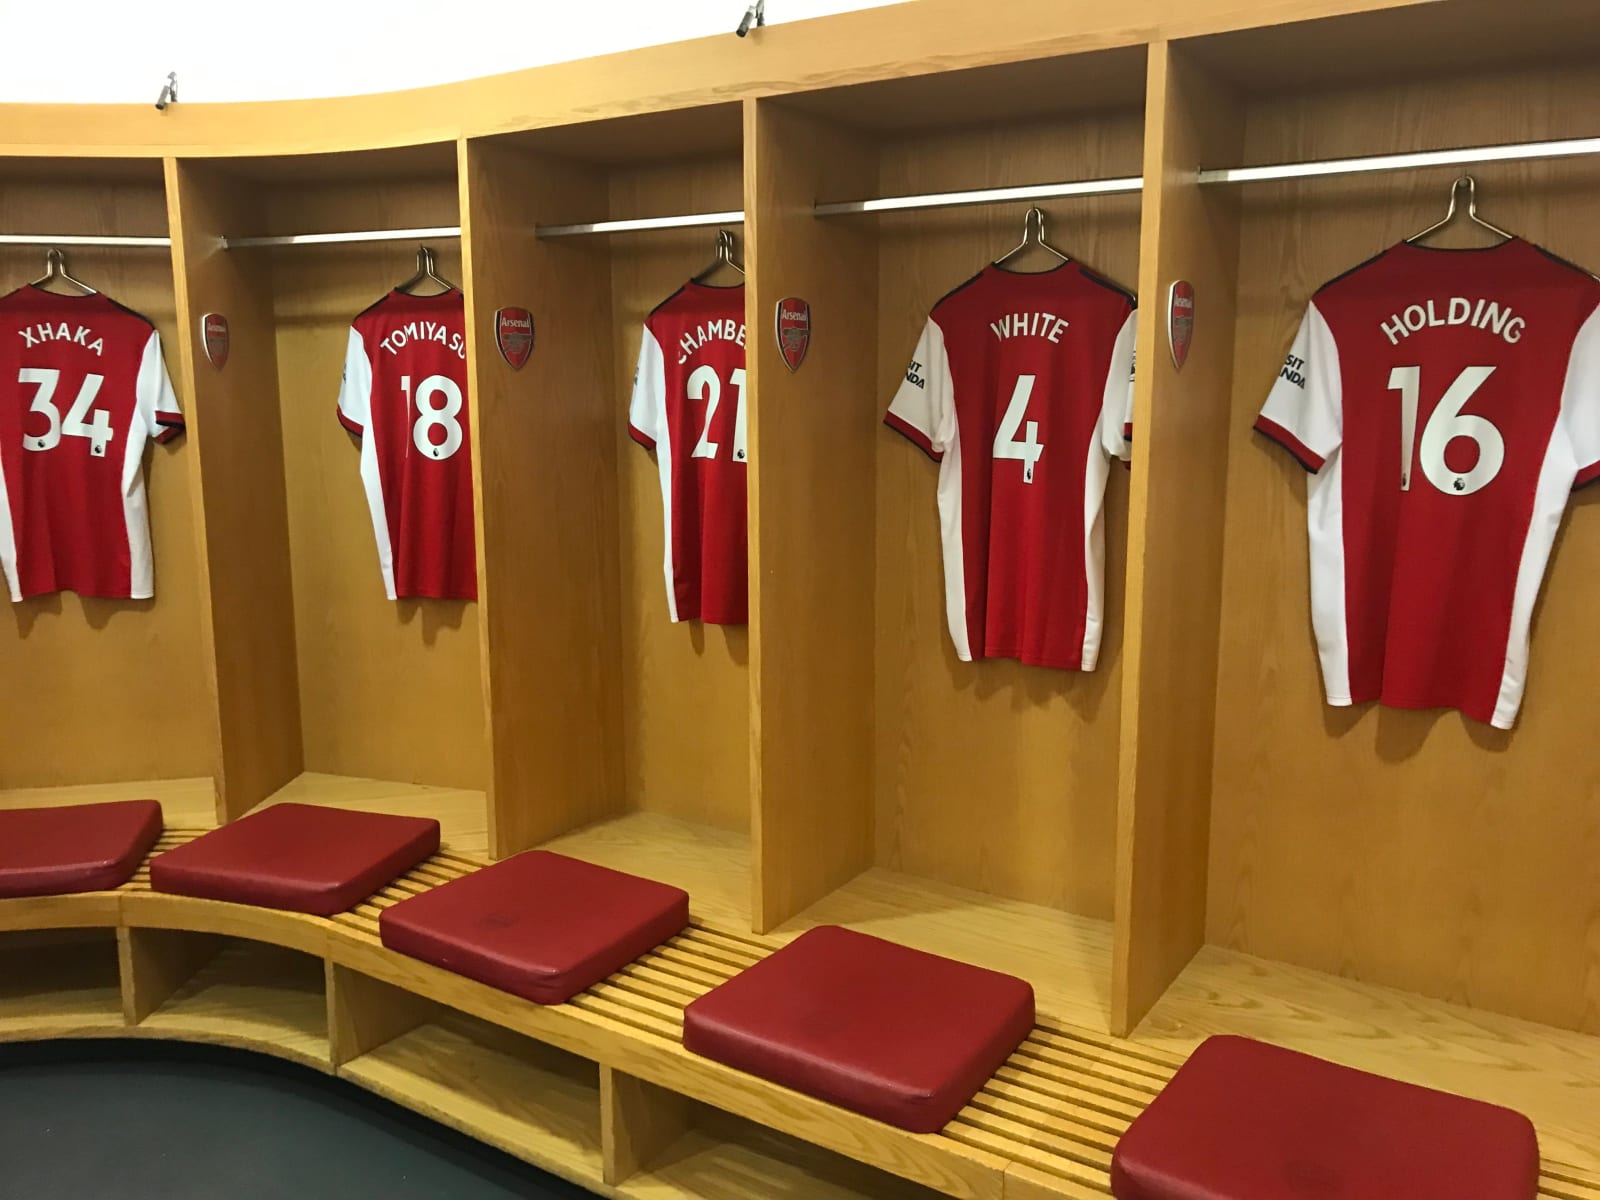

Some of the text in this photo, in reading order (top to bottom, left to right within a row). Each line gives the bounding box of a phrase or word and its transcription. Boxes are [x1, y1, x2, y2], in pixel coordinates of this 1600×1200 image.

[18, 322, 104, 356] XHAKA
[501, 317, 530, 328] Arsenal
[782, 309, 807, 321] Arsenal
[990, 312, 1069, 343] WHITE
[1380, 297, 1526, 345] HOLDING
[678, 319, 746, 364] HAMBE
[18, 367, 114, 458] 34
[401, 374, 463, 460] 18
[687, 365, 748, 463] 21
[993, 374, 1044, 484] 4
[1387, 365, 1505, 496] 16
